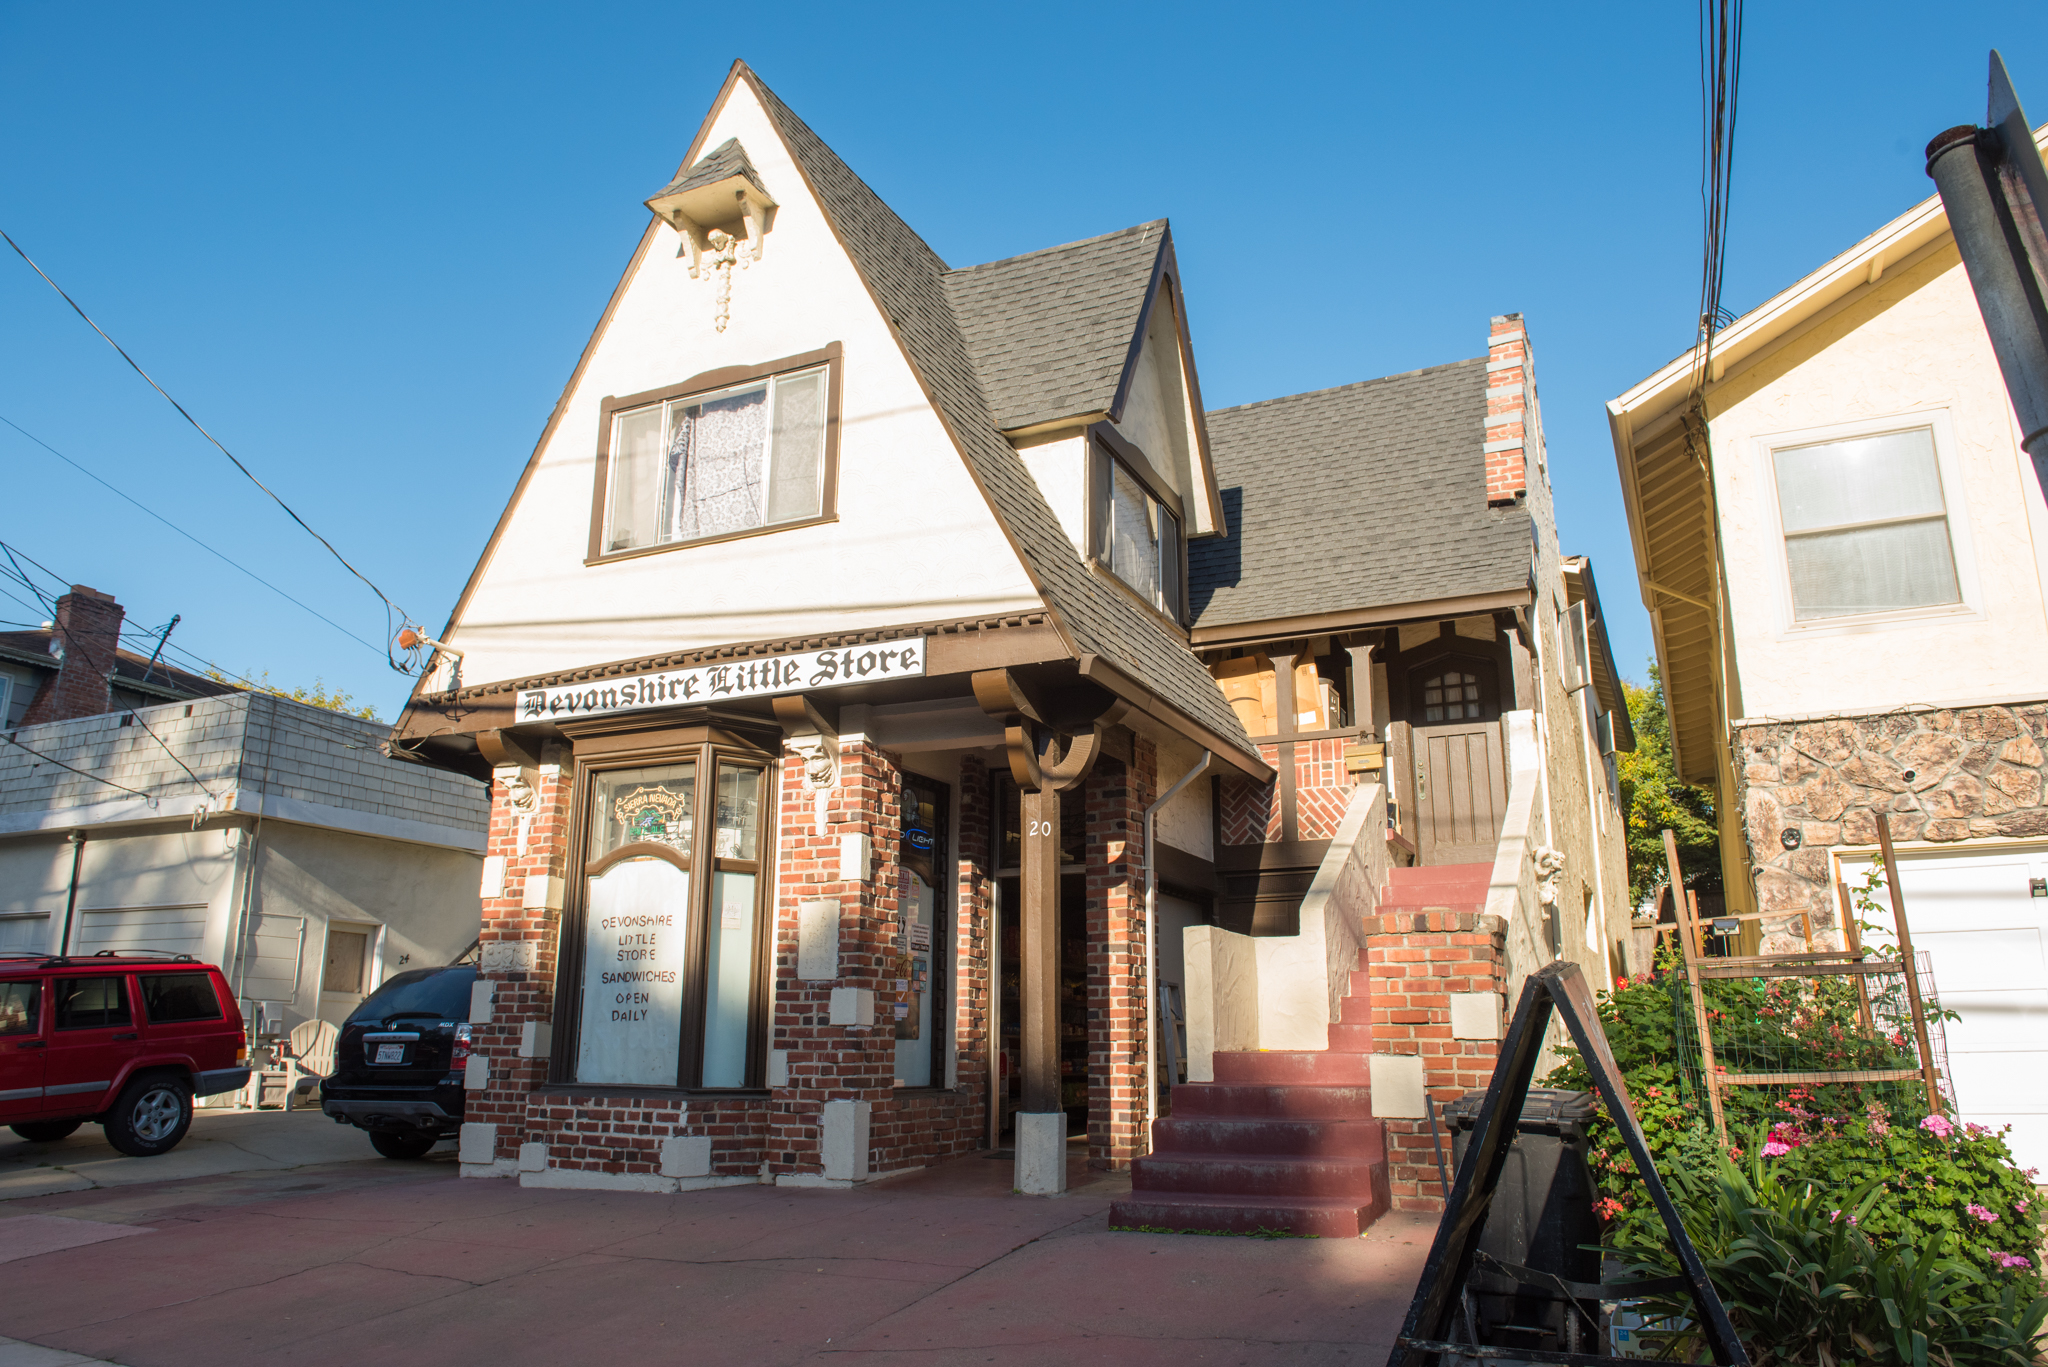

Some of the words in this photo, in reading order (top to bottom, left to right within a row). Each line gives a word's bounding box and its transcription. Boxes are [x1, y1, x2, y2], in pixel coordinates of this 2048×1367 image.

[524, 674, 700, 720] Devonshire
[706, 658, 801, 697] Little
[809, 647, 920, 686] Store
[623, 794, 648, 812] SIERRA
[649, 793, 677, 809] NEVADA
[650, 825, 665, 835] ALE
[1029, 821, 1051, 837] 20
[911, 833, 933, 845] LIGHT
[601, 914, 673, 930] DEVONSHIRE
[618, 933, 656, 946] LITTLE
[398, 953, 410, 965] 24
[617, 948, 656, 962] STORE
[601, 970, 676, 984] SANDWICHES
[615, 992, 649, 1004] OPEN
[612, 1009, 648, 1022] DAILY
